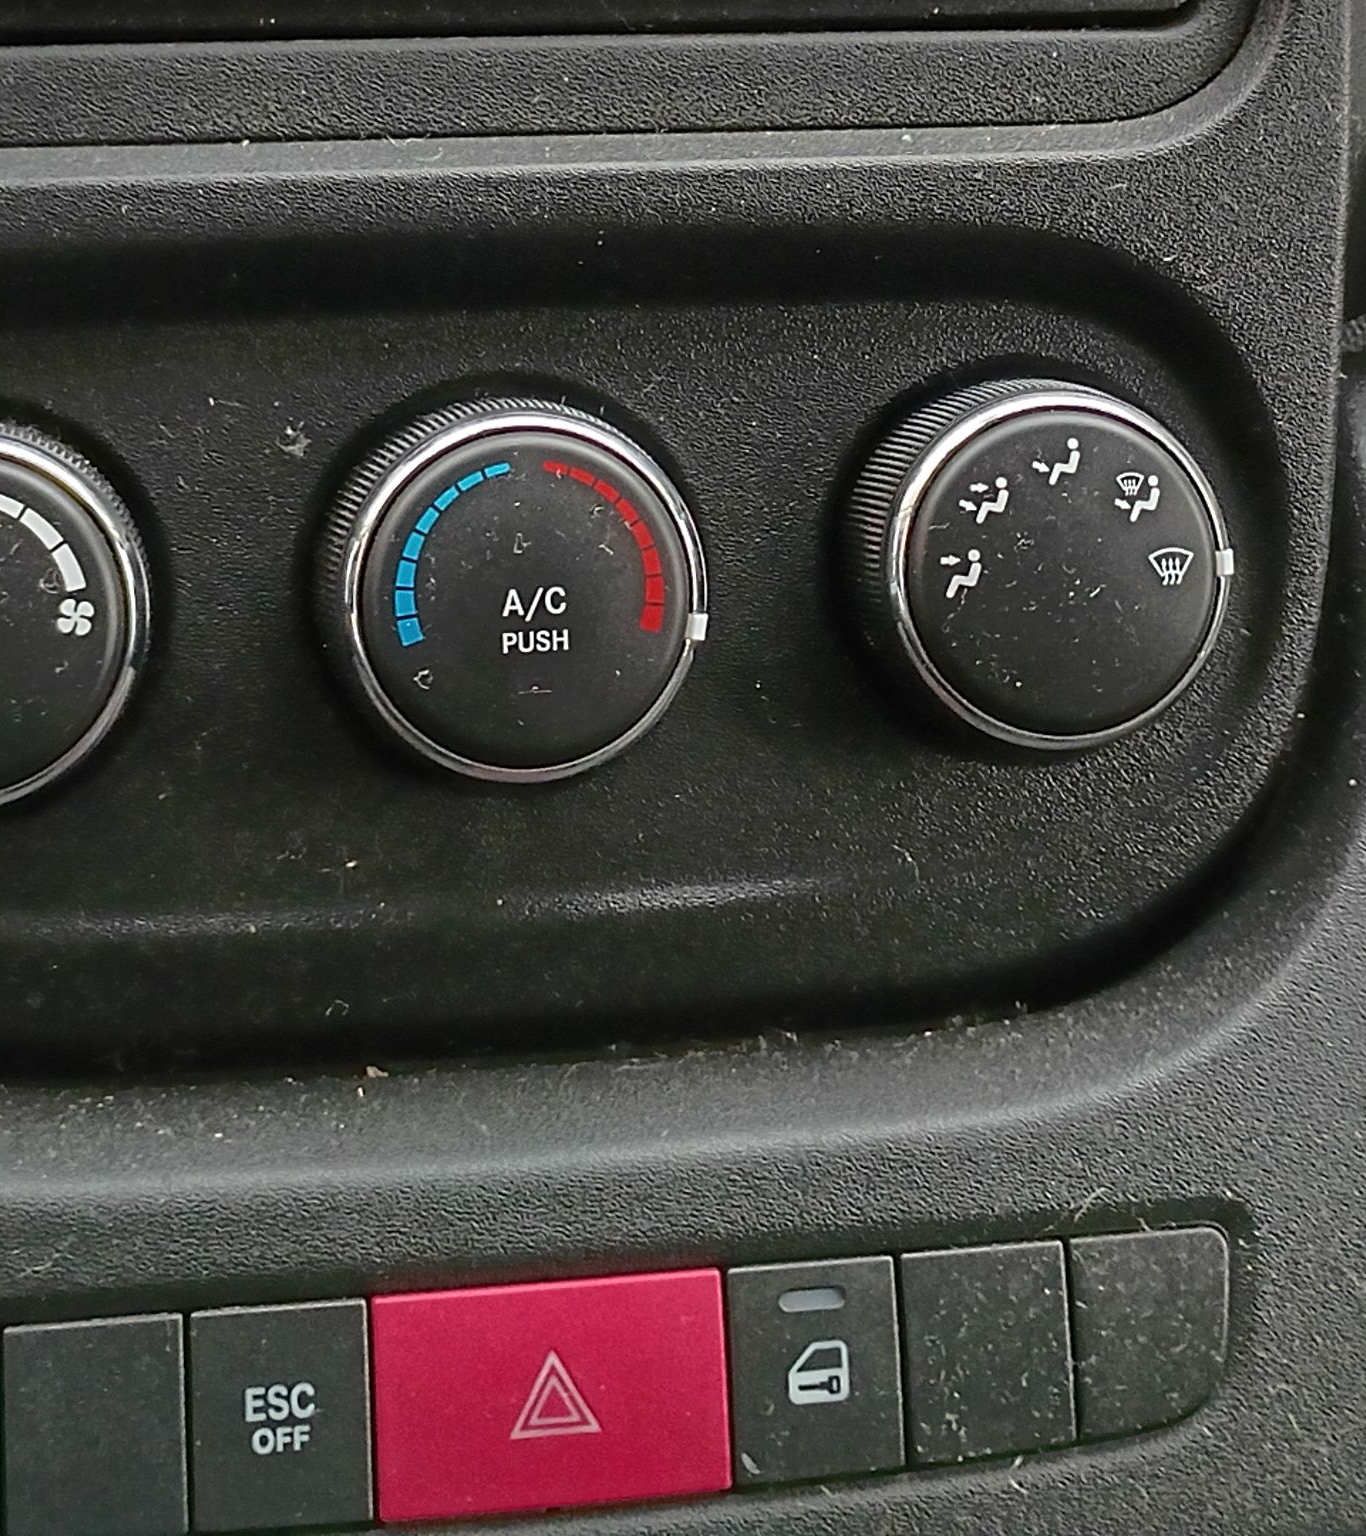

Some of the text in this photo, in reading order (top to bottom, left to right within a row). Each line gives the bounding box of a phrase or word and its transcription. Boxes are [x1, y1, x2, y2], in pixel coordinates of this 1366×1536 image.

[502, 586, 567, 623] A/C
[502, 628, 569, 654] PUSH
[245, 1382, 315, 1424] ESC
[252, 1425, 311, 1455] OFF
